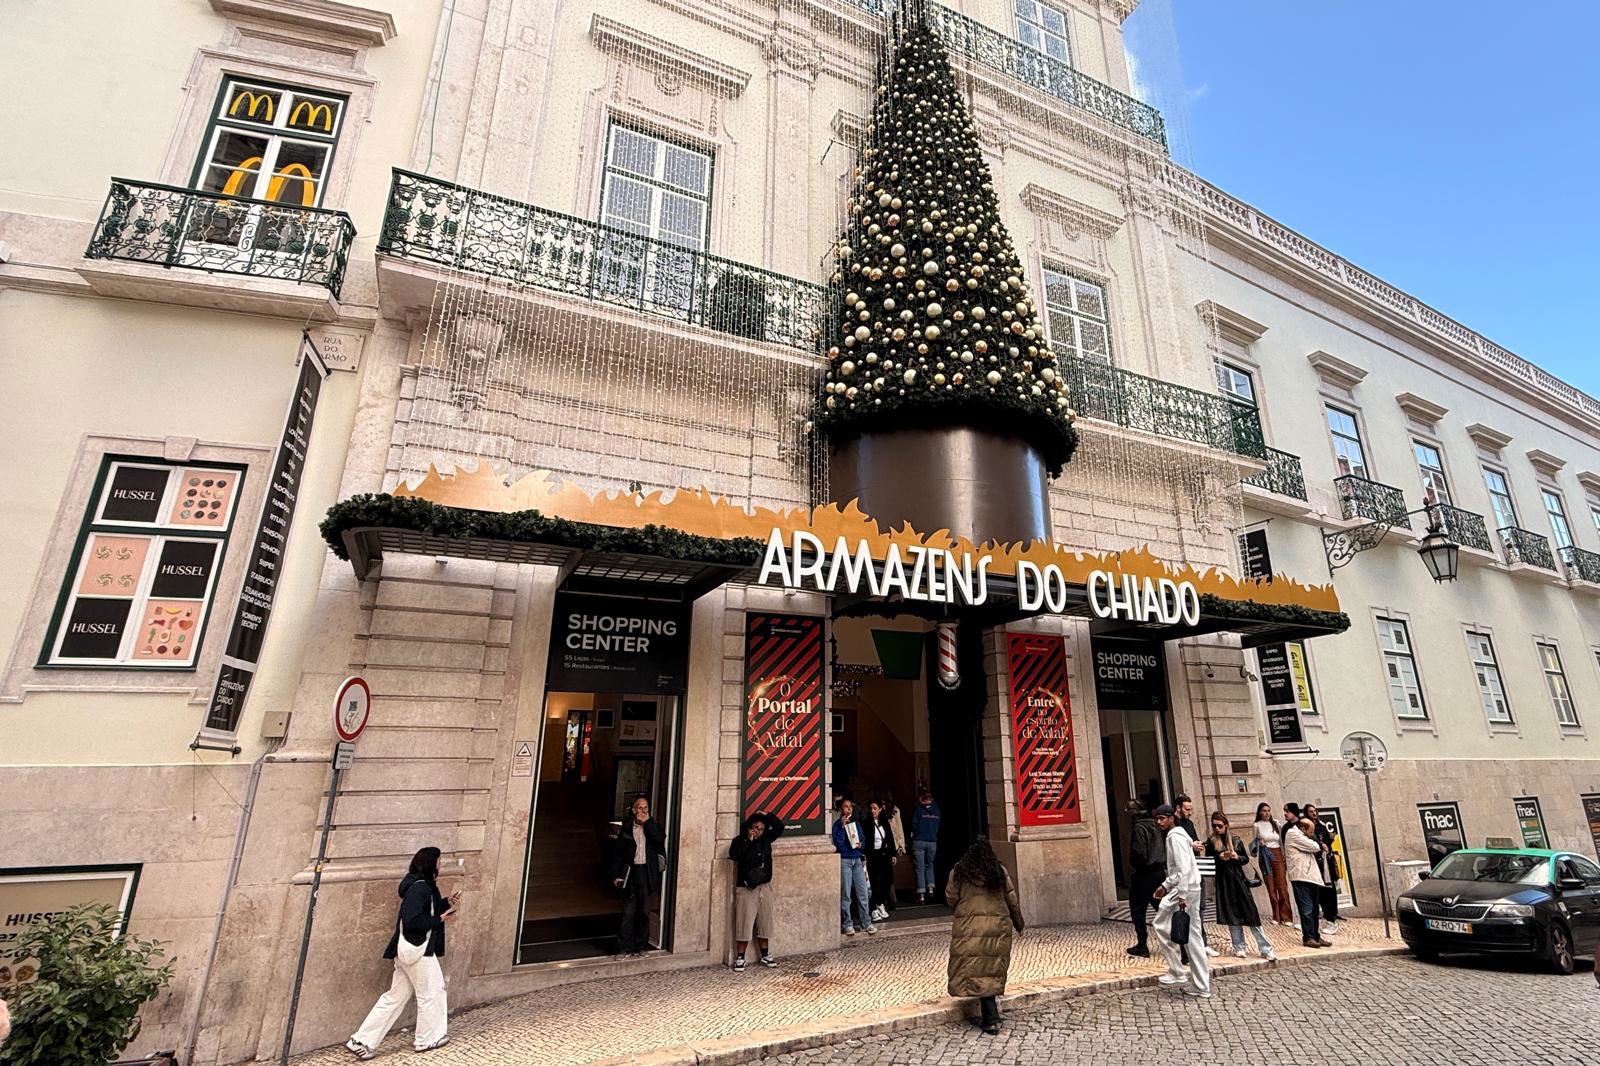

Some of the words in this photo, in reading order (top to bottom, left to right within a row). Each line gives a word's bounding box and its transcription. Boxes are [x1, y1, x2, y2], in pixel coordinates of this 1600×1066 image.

[323, 336, 342, 345] RUA
[320, 353, 347, 362] ARMO
[113, 488, 157, 501] HUSSEL
[161, 564, 205, 577] HUSSEL
[757, 527, 993, 606] ARMAZENS
[1015, 559, 1067, 613] DO
[1087, 570, 1201, 627] CHIADO
[71, 622, 118, 635] HUSSEL
[567, 613, 677, 636] SHOPPING
[566, 633, 650, 653] CENTER
[1097, 652, 1157, 667] SHOPPING
[571, 663, 610, 671] Restaurantes
[1098, 667, 1144, 680] CENTER
[780, 682, 791, 697] O
[758, 697, 812, 714] Portal
[1027, 696, 1055, 708] Entre
[774, 715, 795, 730] de
[1022, 726, 1037, 739] de
[766, 732, 803, 748] Natal
[1517, 804, 1536, 817] fnac
[1424, 810, 1454, 829] fnac
